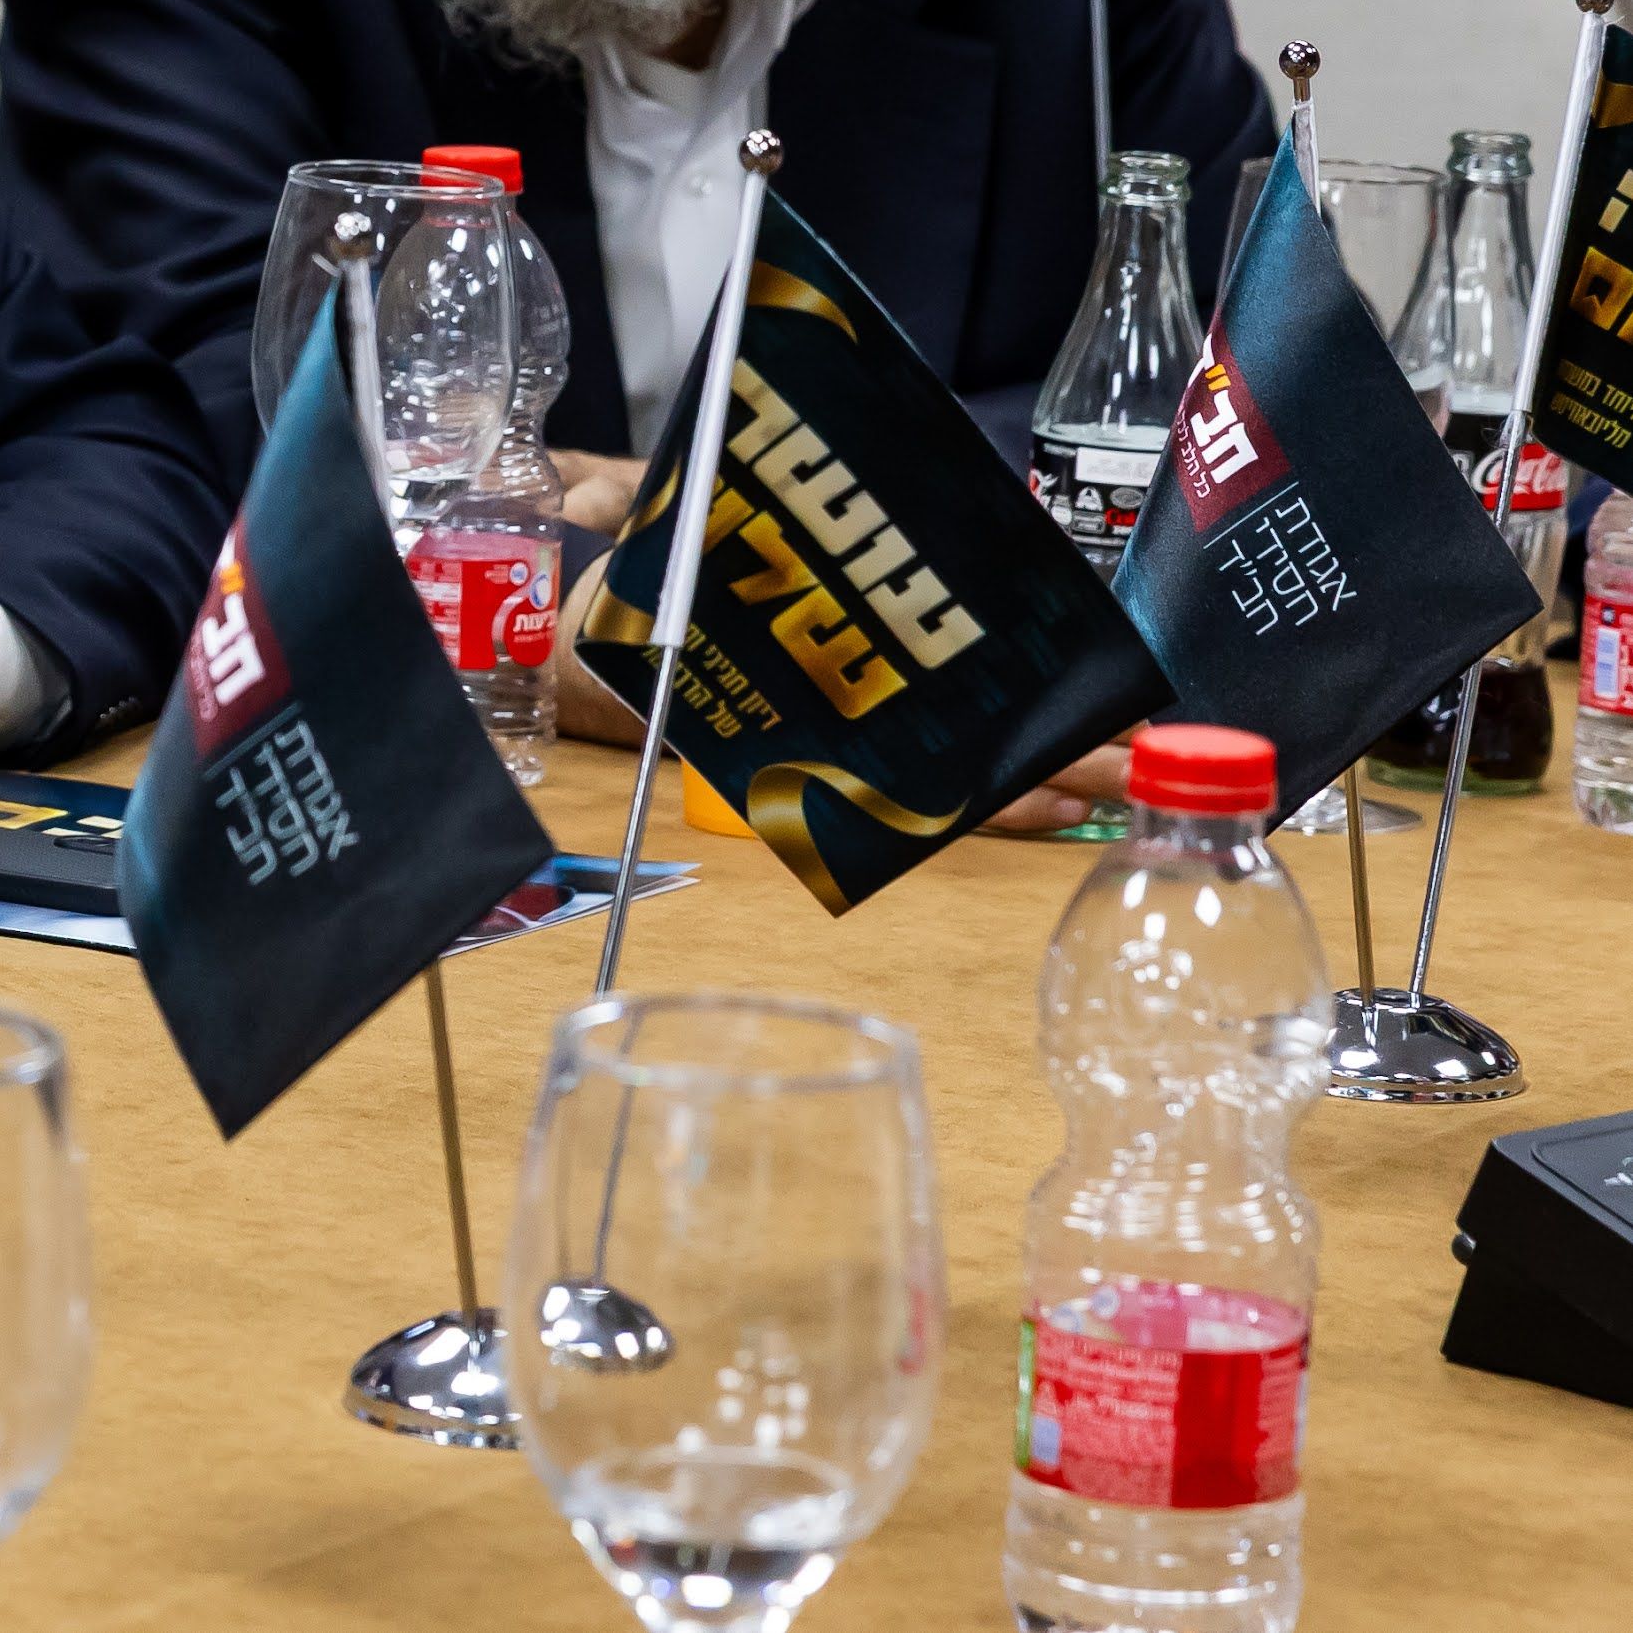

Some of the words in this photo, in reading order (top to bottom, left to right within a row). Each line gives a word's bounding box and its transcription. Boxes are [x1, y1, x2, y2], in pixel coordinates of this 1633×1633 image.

[703, 477, 910, 721] שלו
[1219, 539, 1279, 636] חב"ד
[1256, 517, 1319, 626] חסידי
[1274, 497, 1358, 611] אגודת
[201, 530, 267, 706] חב"
[704, 698, 743, 739] של
[252, 740, 321, 878] חסידי
[274, 719, 360, 862] אגודת
